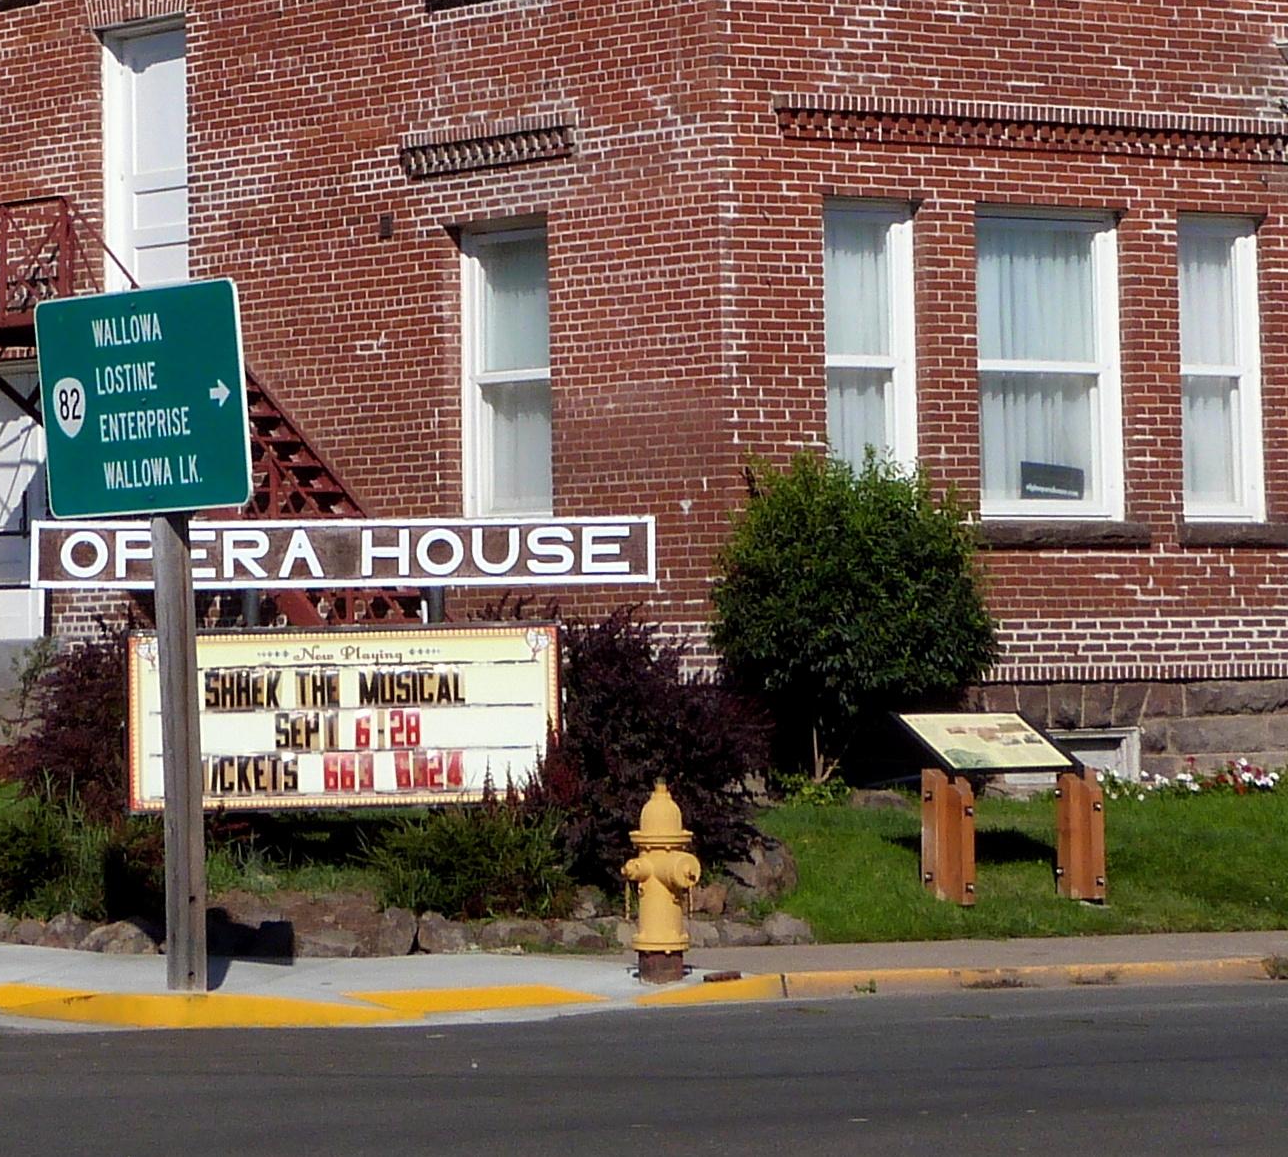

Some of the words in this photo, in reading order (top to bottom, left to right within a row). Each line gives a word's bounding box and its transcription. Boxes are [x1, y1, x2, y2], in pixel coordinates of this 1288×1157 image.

[91, 312, 163, 348] WALLOWA
[95, 361, 158, 395] LOSTINE
[58, 387, 82, 421] 82
[99, 406, 191, 443] ENTERPRISE
[103, 457, 173, 490] WALLOWA
[179, 454, 203, 484] LK.
[361, 526, 631, 576] HOUSE
[292, 644, 334, 661] Now
[340, 644, 403, 665] Playing
[295, 670, 340, 707] THE
[358, 668, 466, 706] MUSICAL
[275, 711, 339, 749] SEPT
[202, 756, 298, 791] ICKETS
